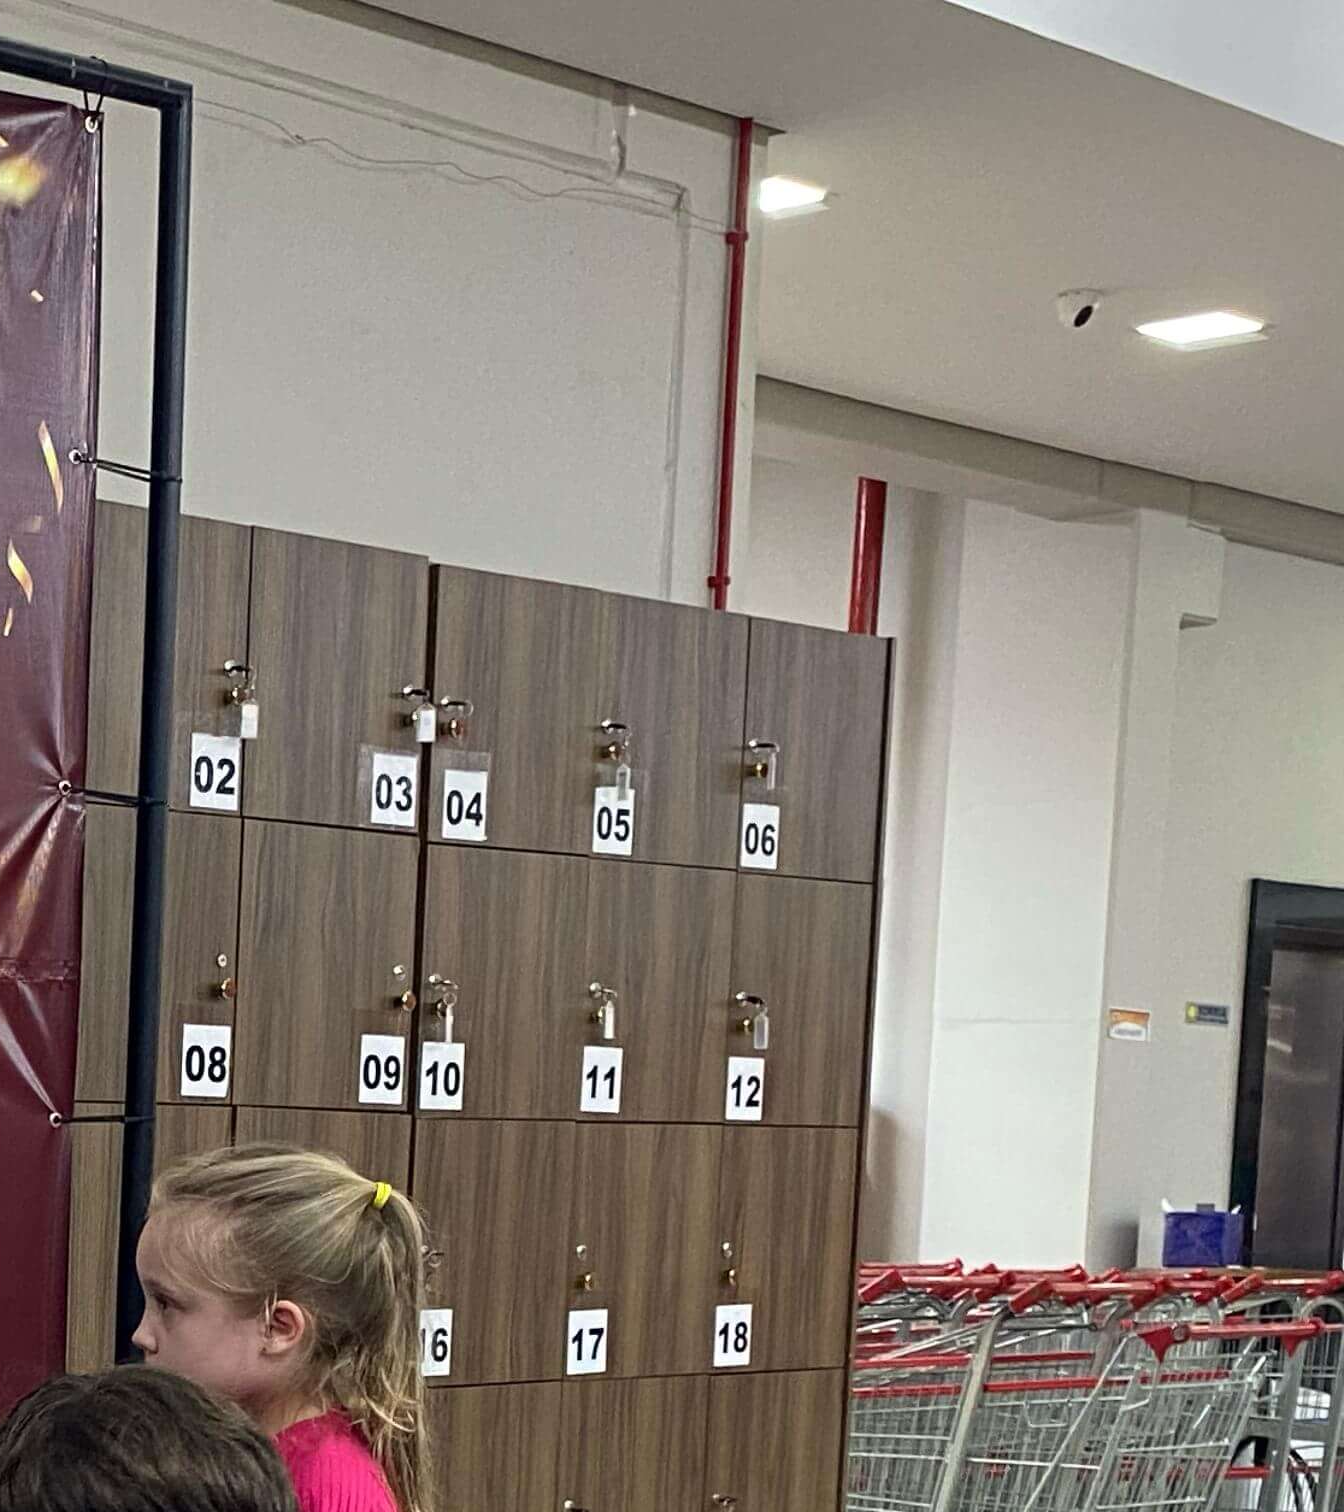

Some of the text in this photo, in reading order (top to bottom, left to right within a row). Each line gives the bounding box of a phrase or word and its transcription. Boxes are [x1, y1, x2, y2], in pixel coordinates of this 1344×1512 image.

[194, 756, 235, 796] 02
[375, 775, 413, 813] 03
[446, 790, 484, 828] 04
[596, 807, 630, 843] 05
[744, 824, 776, 857] 06
[184, 1046, 227, 1084] 08
[362, 1055, 402, 1091] 09
[424, 1060, 461, 1097] 10
[585, 1065, 616, 1100] 11
[731, 1075, 761, 1108] 12
[571, 1327, 605, 1361] 17
[718, 1321, 749, 1355] 18
